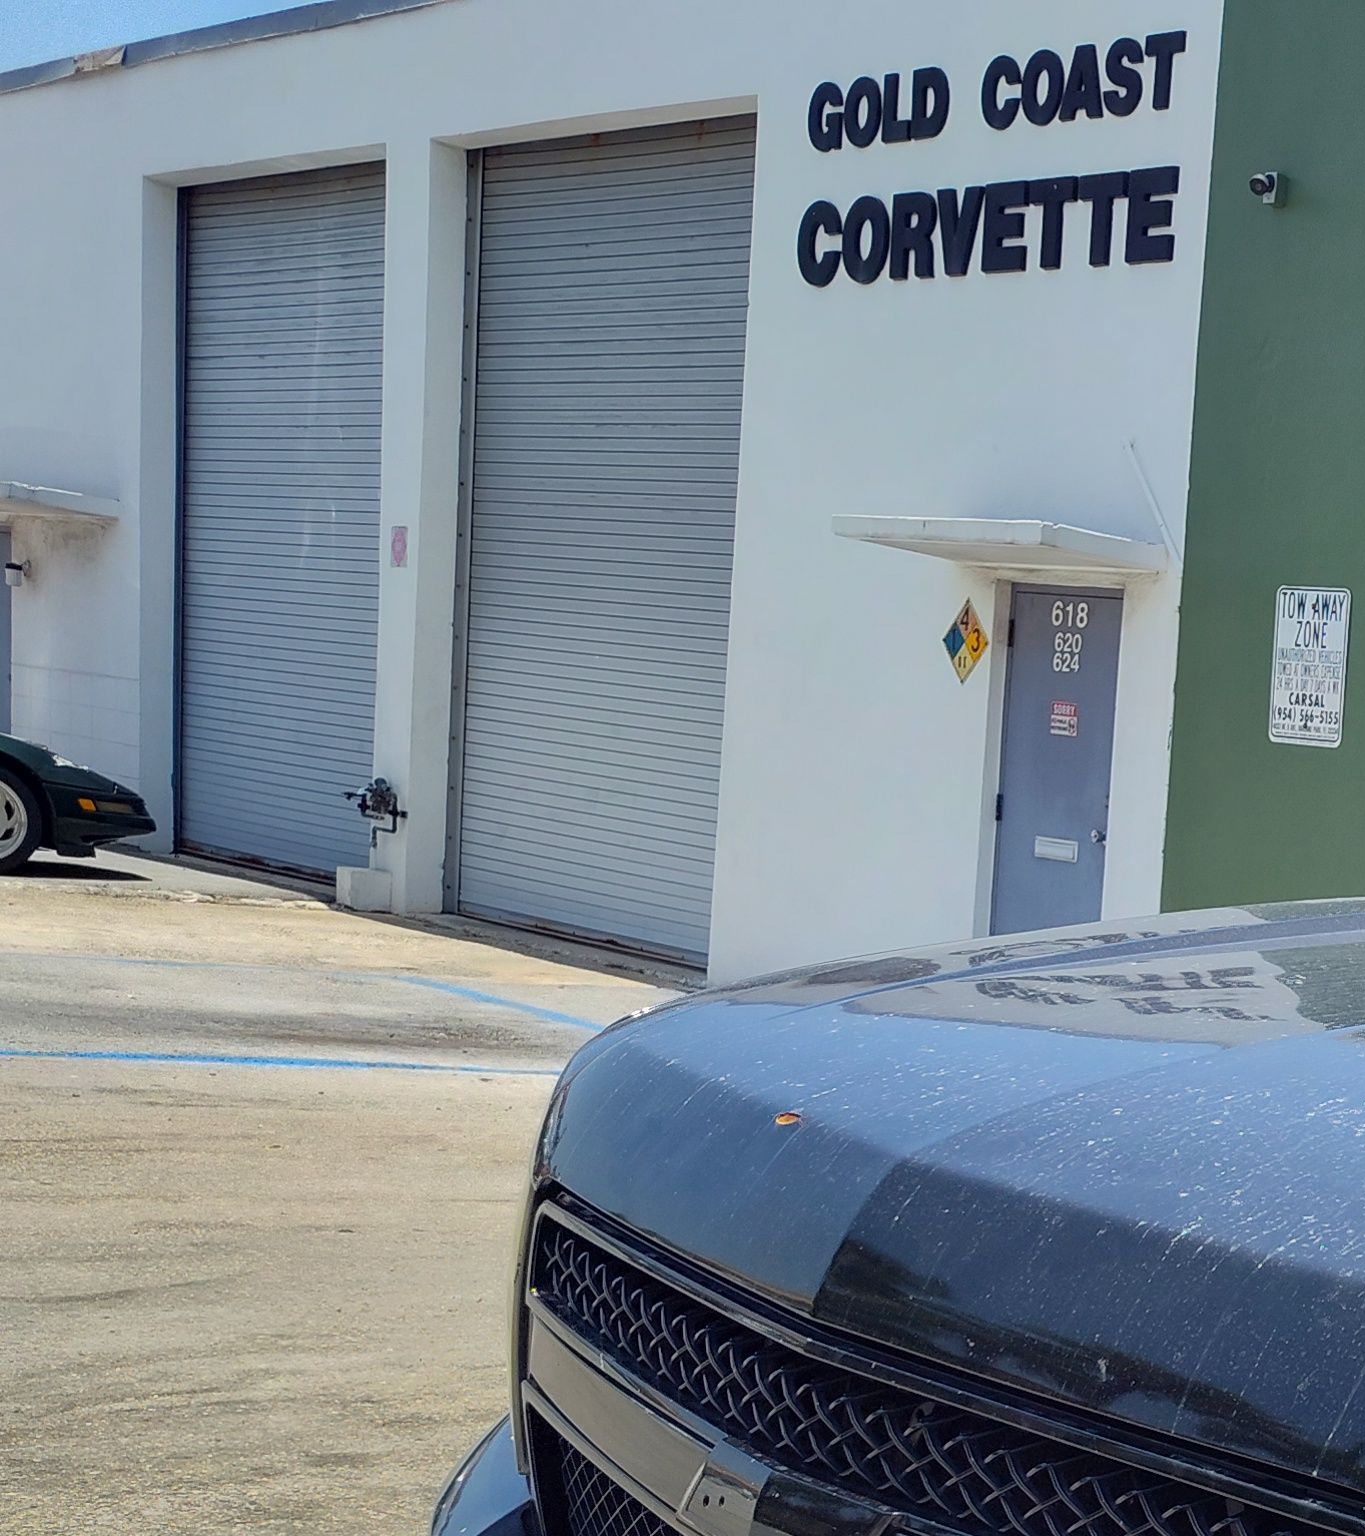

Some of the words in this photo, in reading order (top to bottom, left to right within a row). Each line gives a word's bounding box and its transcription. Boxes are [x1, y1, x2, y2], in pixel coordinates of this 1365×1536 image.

[807, 66, 950, 152] GOLD
[980, 30, 1187, 131] COAST
[797, 165, 1180, 287] CORVETTE
[960, 607, 970, 631] 4
[1051, 601, 1089, 628] 618
[1282, 592, 1307, 619] TOW
[1312, 593, 1347, 621] AWAY
[971, 628, 981, 653] 3
[1054, 632, 1082, 653] 620
[1294, 621, 1328, 648] ZONE
[1053, 653, 1080, 672] 624
[1289, 692, 1325, 708] CARSAL
[1273, 705, 1296, 722] (954)
[1300, 708, 1339, 725] 566-5155
